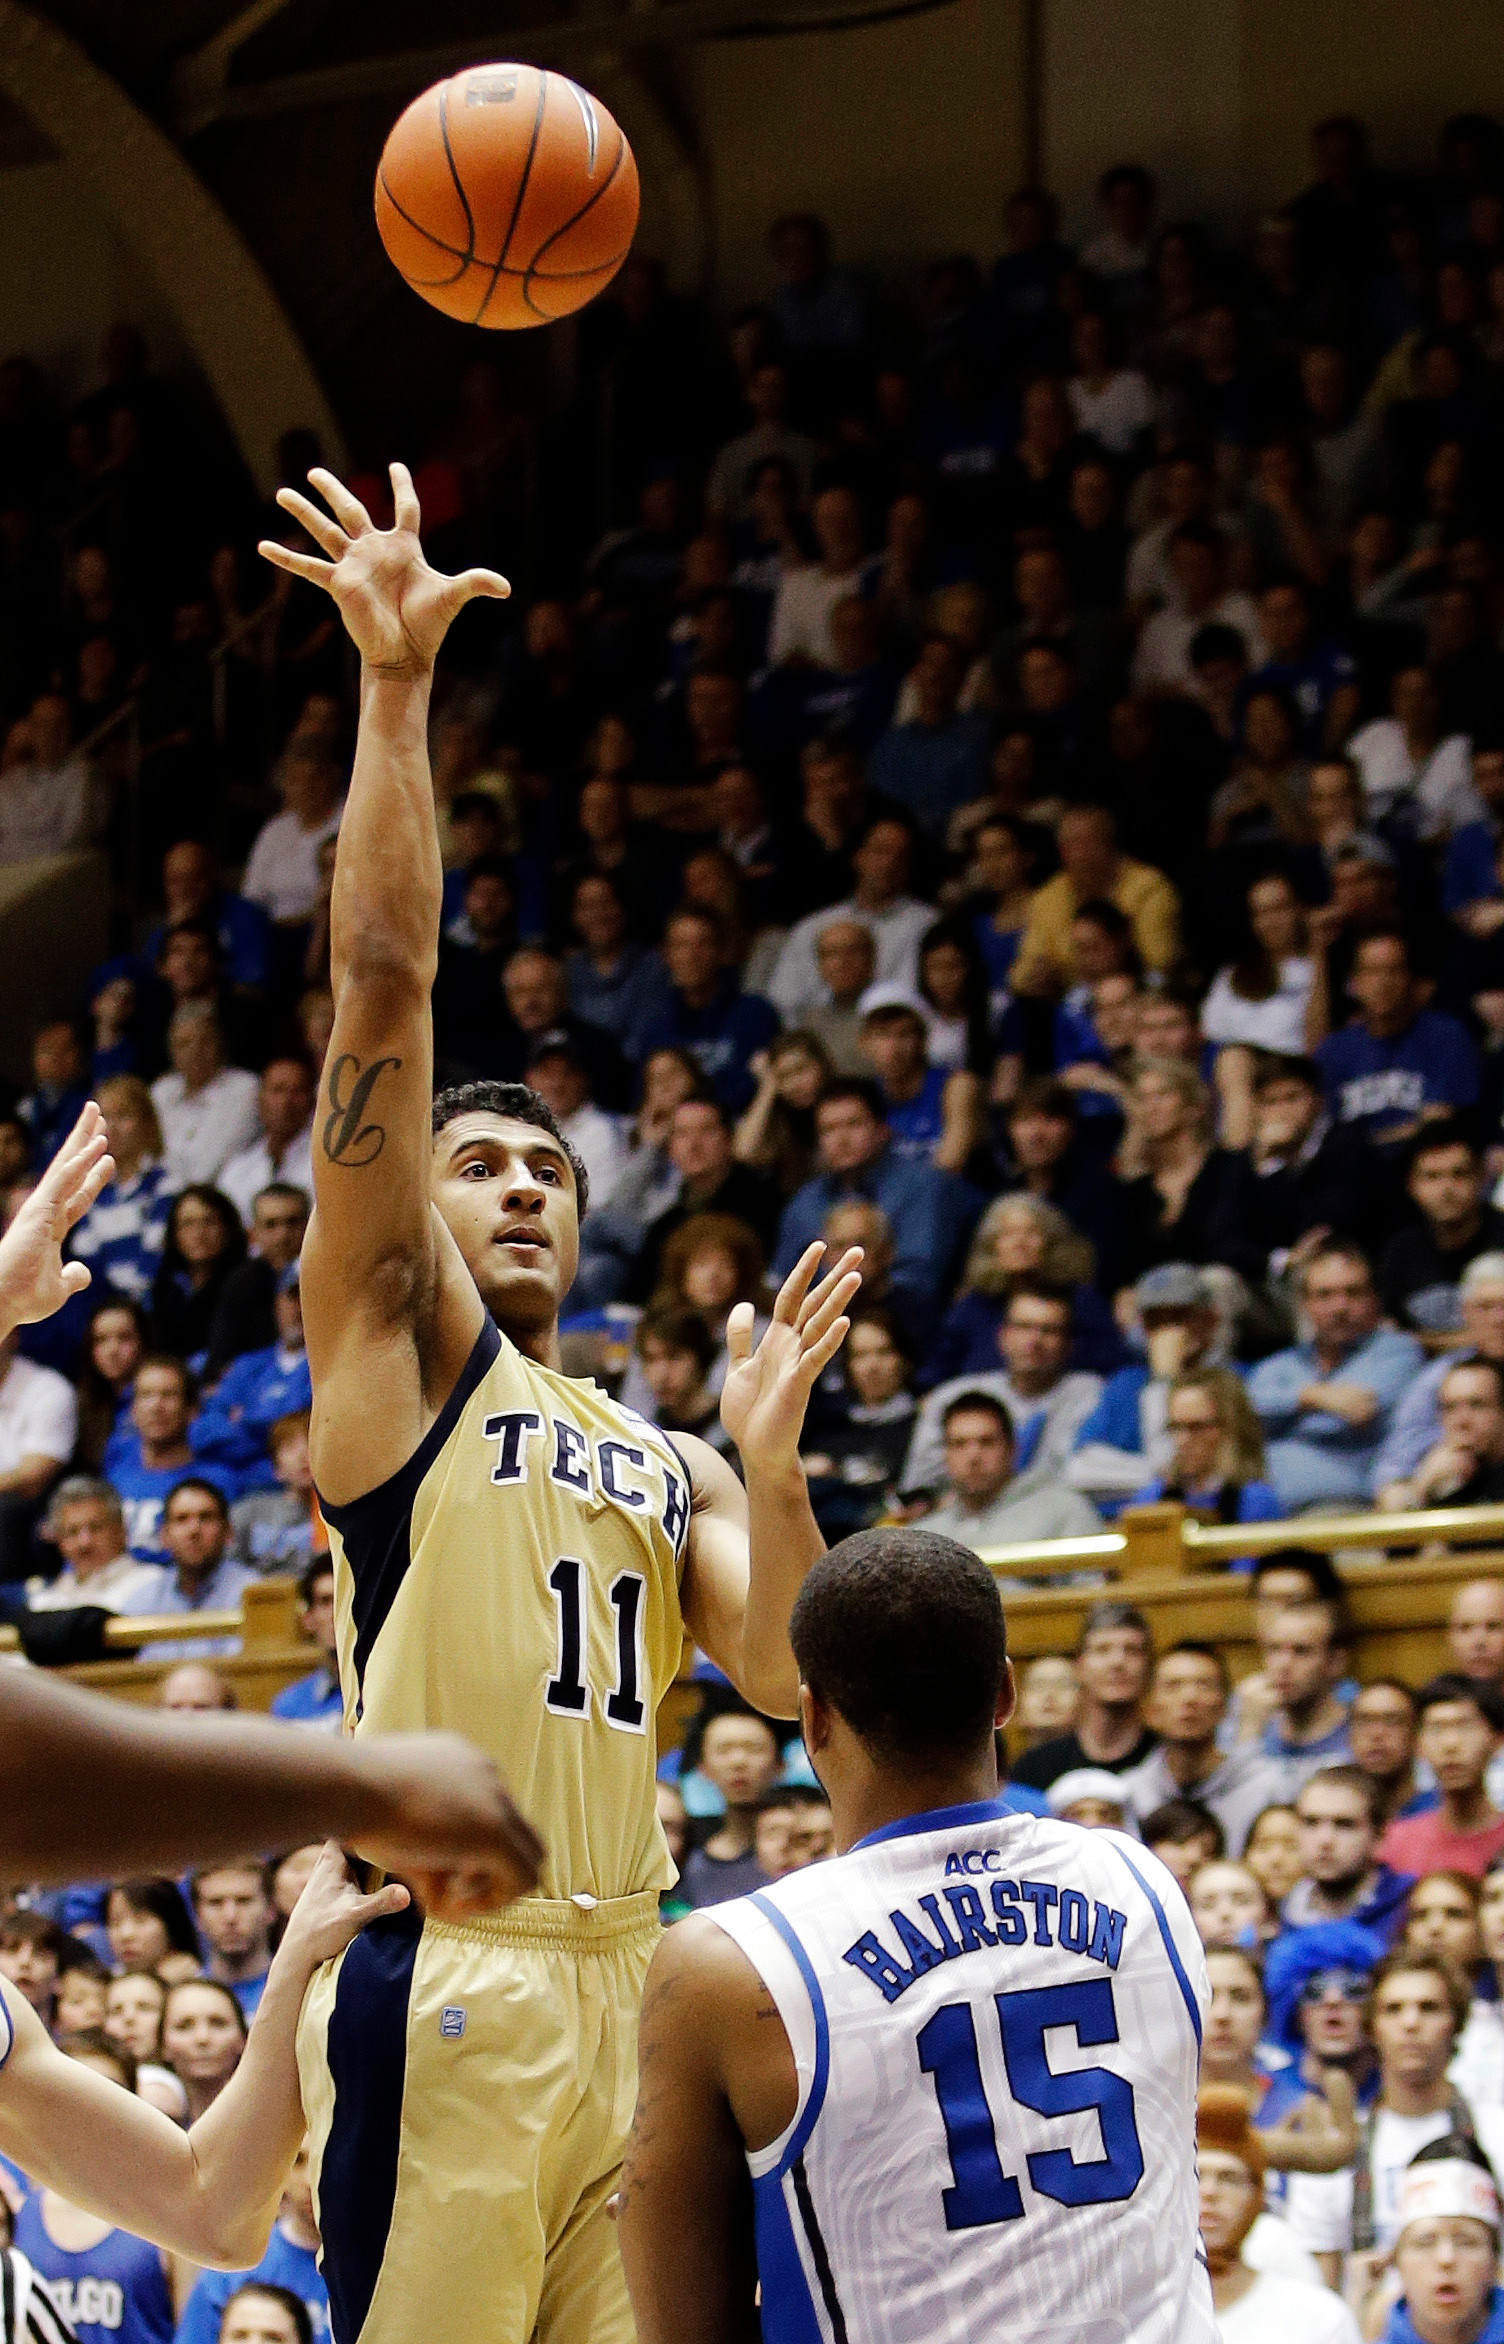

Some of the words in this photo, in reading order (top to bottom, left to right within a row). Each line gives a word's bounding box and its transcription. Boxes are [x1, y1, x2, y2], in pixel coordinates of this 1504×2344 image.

[482, 1409, 691, 1563] TECH
[546, 1556, 647, 1736] 11
[944, 1850, 1002, 1877] ACC
[842, 1879, 1128, 2004] HAIRSTON
[916, 1977, 1145, 2231] 15
